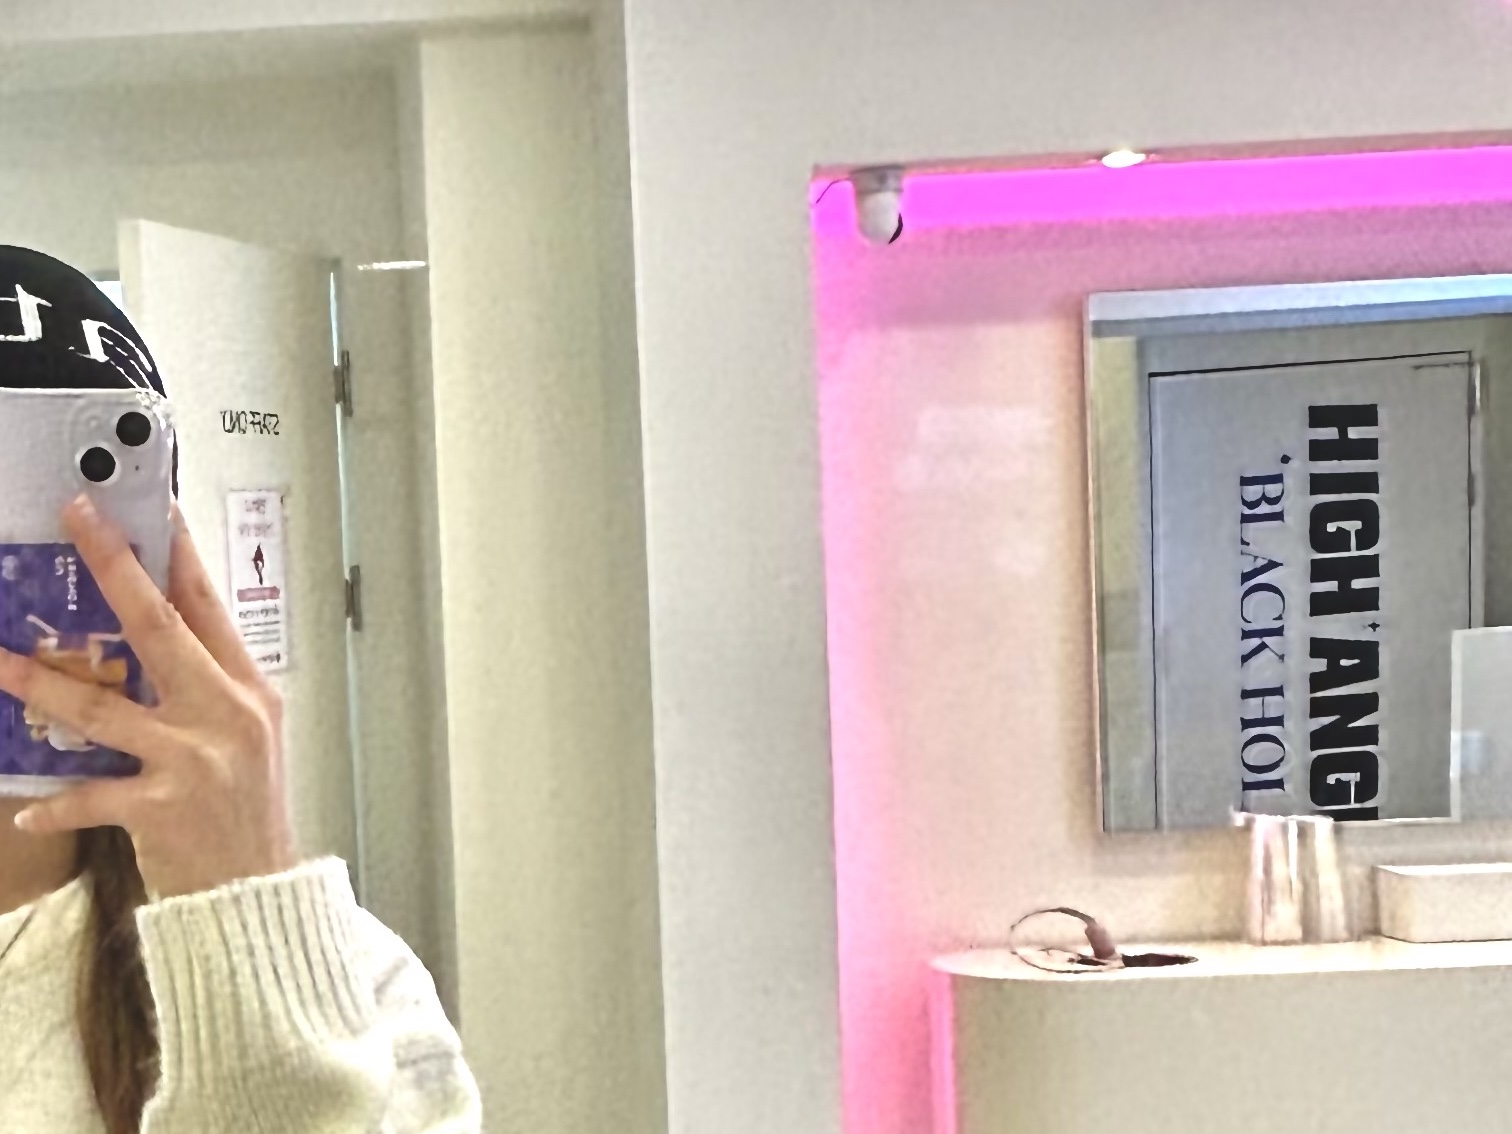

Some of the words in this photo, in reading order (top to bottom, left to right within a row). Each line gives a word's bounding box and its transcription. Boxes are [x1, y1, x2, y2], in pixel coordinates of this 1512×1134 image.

[1240, 473, 1286, 668] BLACK
[1308, 404, 1380, 617] HIGH
[1308, 637, 1380, 820] ANG
